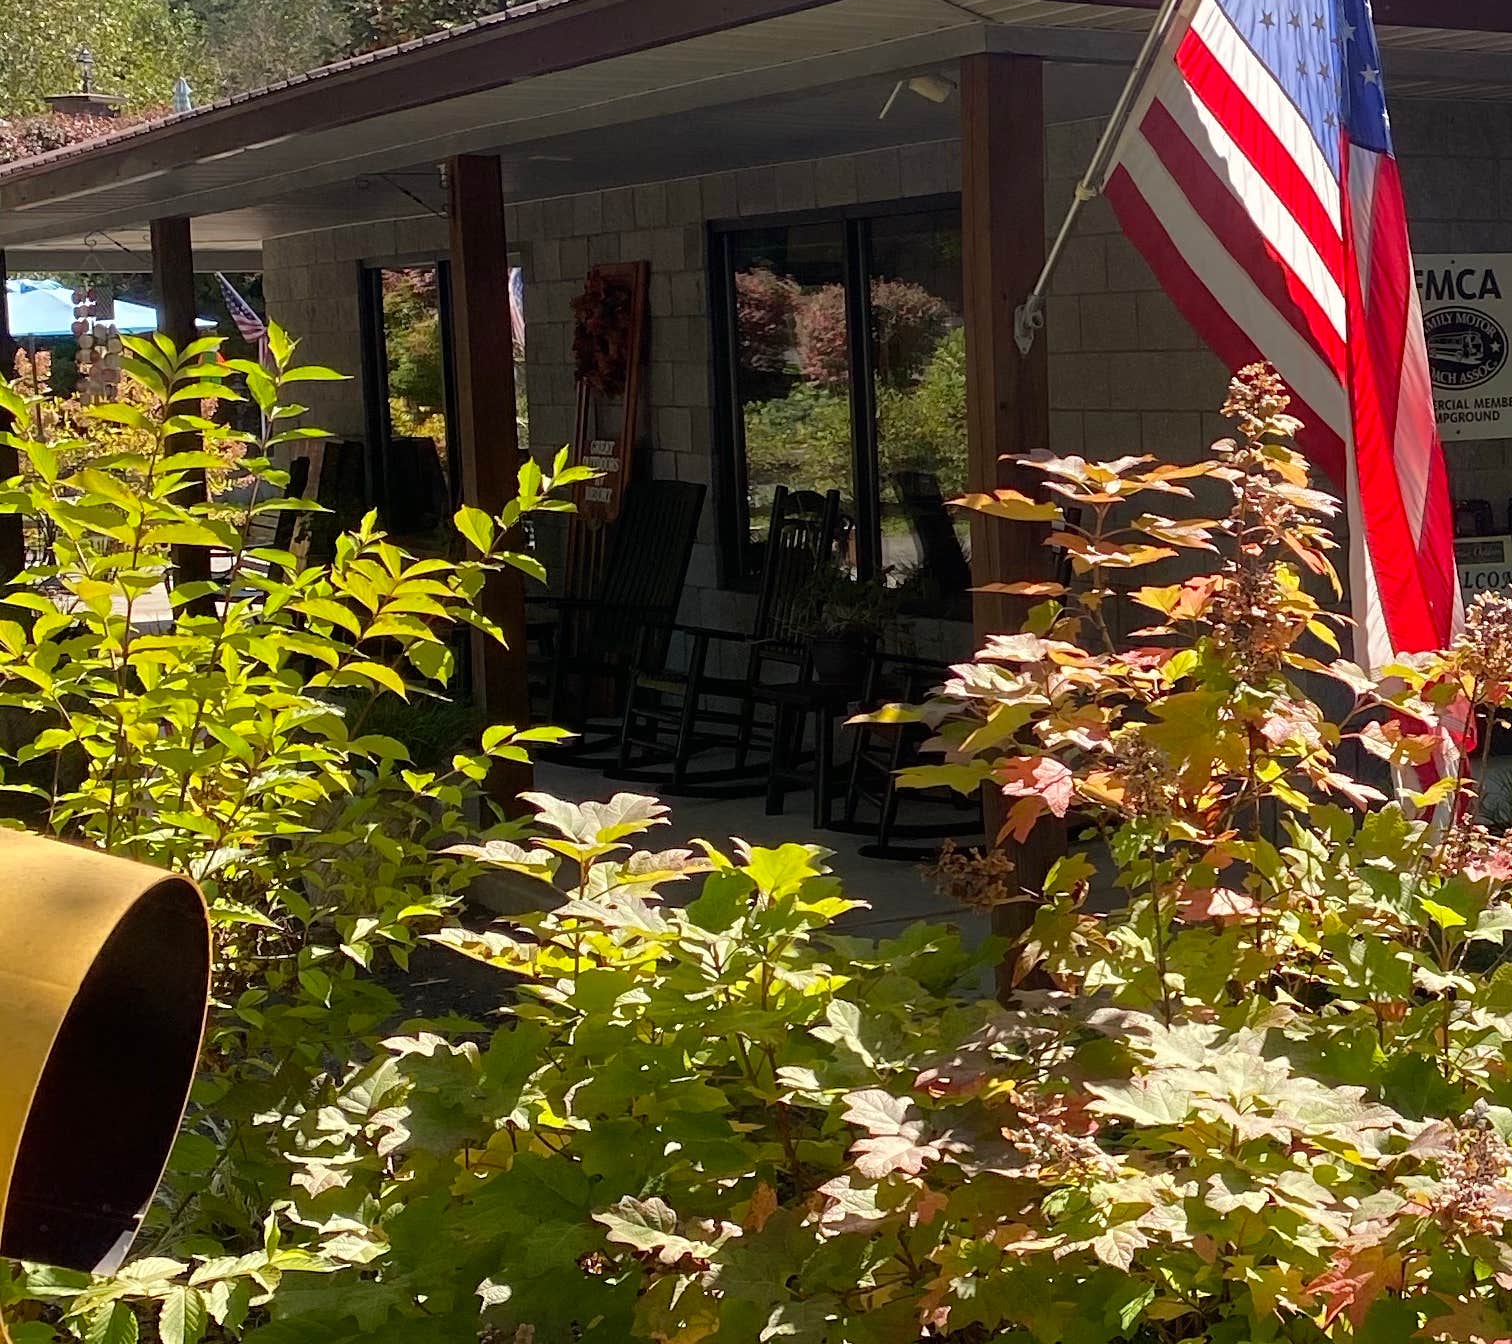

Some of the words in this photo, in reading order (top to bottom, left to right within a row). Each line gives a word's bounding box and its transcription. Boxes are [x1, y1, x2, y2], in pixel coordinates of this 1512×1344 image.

[1425, 312, 1453, 333] MILY
[1455, 312, 1497, 338] MOTOR
[1433, 399, 1469, 411] ERCIAL
[1435, 411, 1500, 424] MPGROUND
